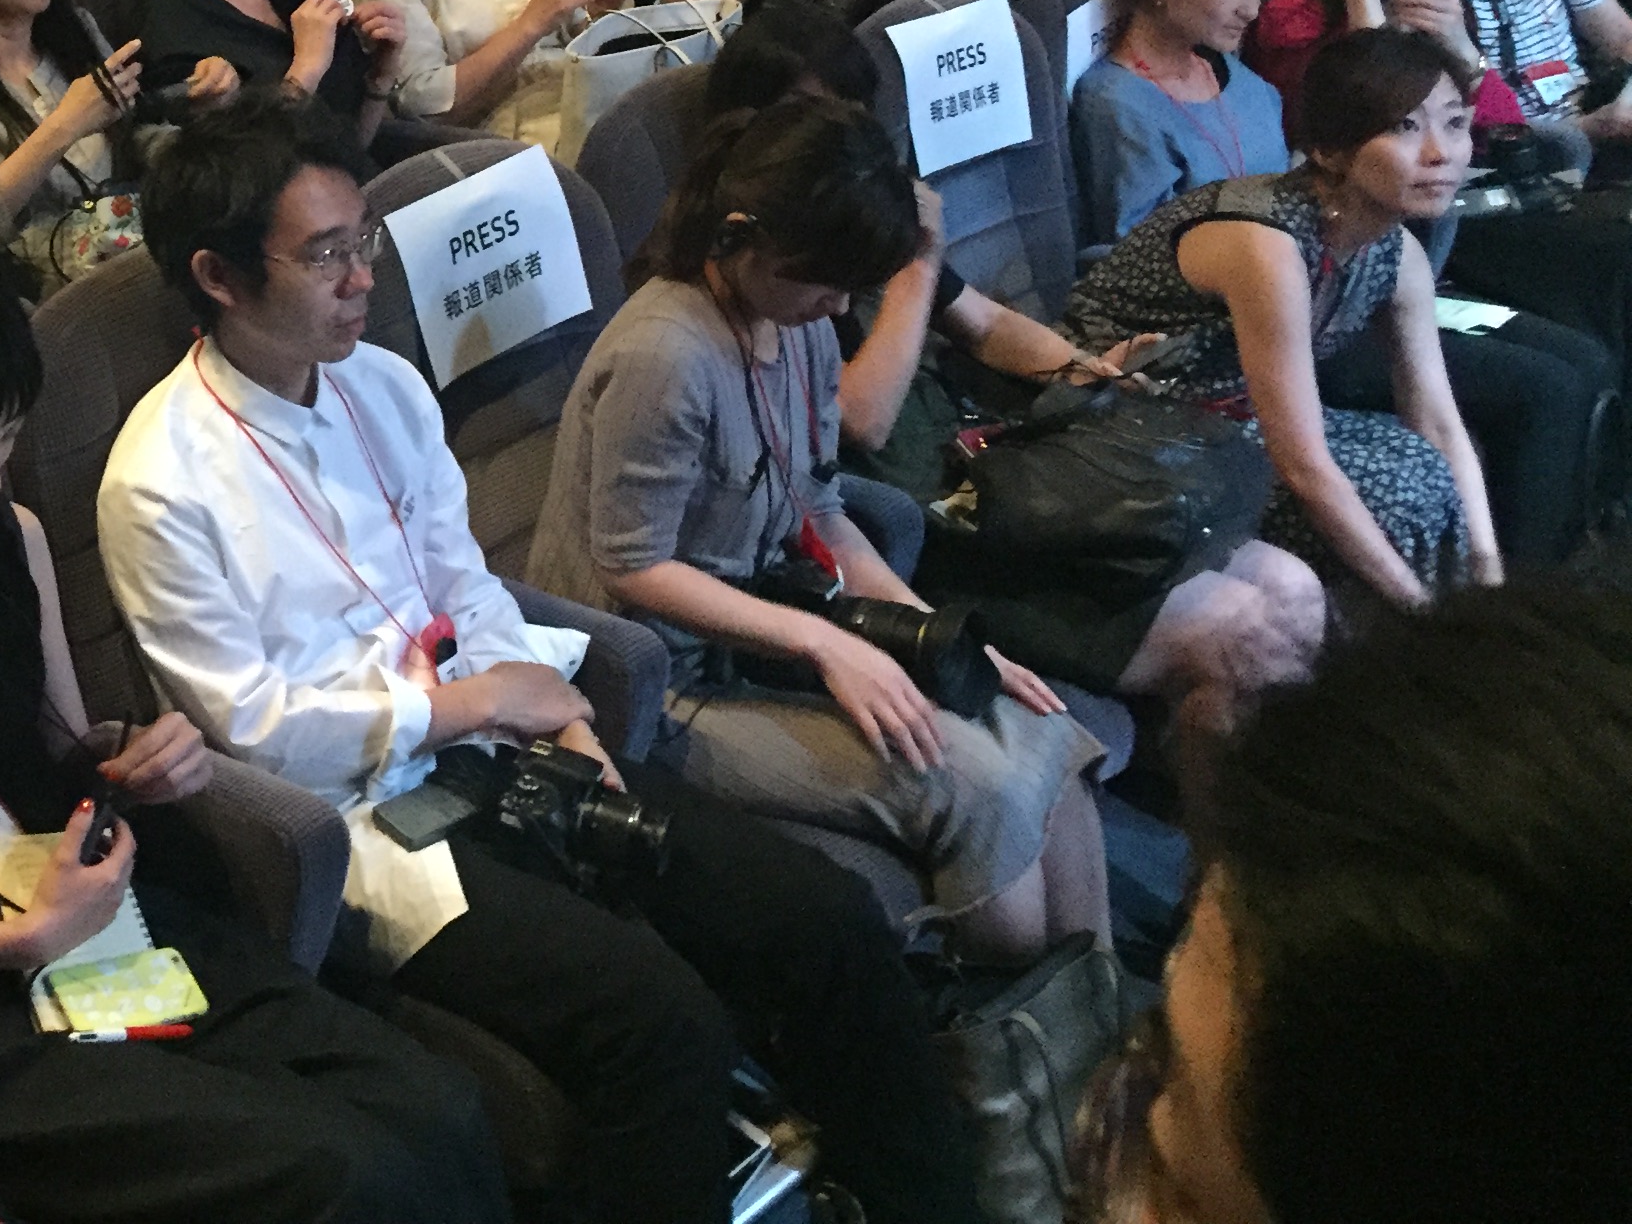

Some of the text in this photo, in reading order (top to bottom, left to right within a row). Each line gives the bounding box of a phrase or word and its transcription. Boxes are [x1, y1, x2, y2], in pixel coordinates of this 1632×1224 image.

[936, 42, 987, 78] PRESS
[929, 80, 1000, 124] 報道関係者
[448, 209, 520, 266] PRESS
[442, 250, 543, 321] 報道関係者
